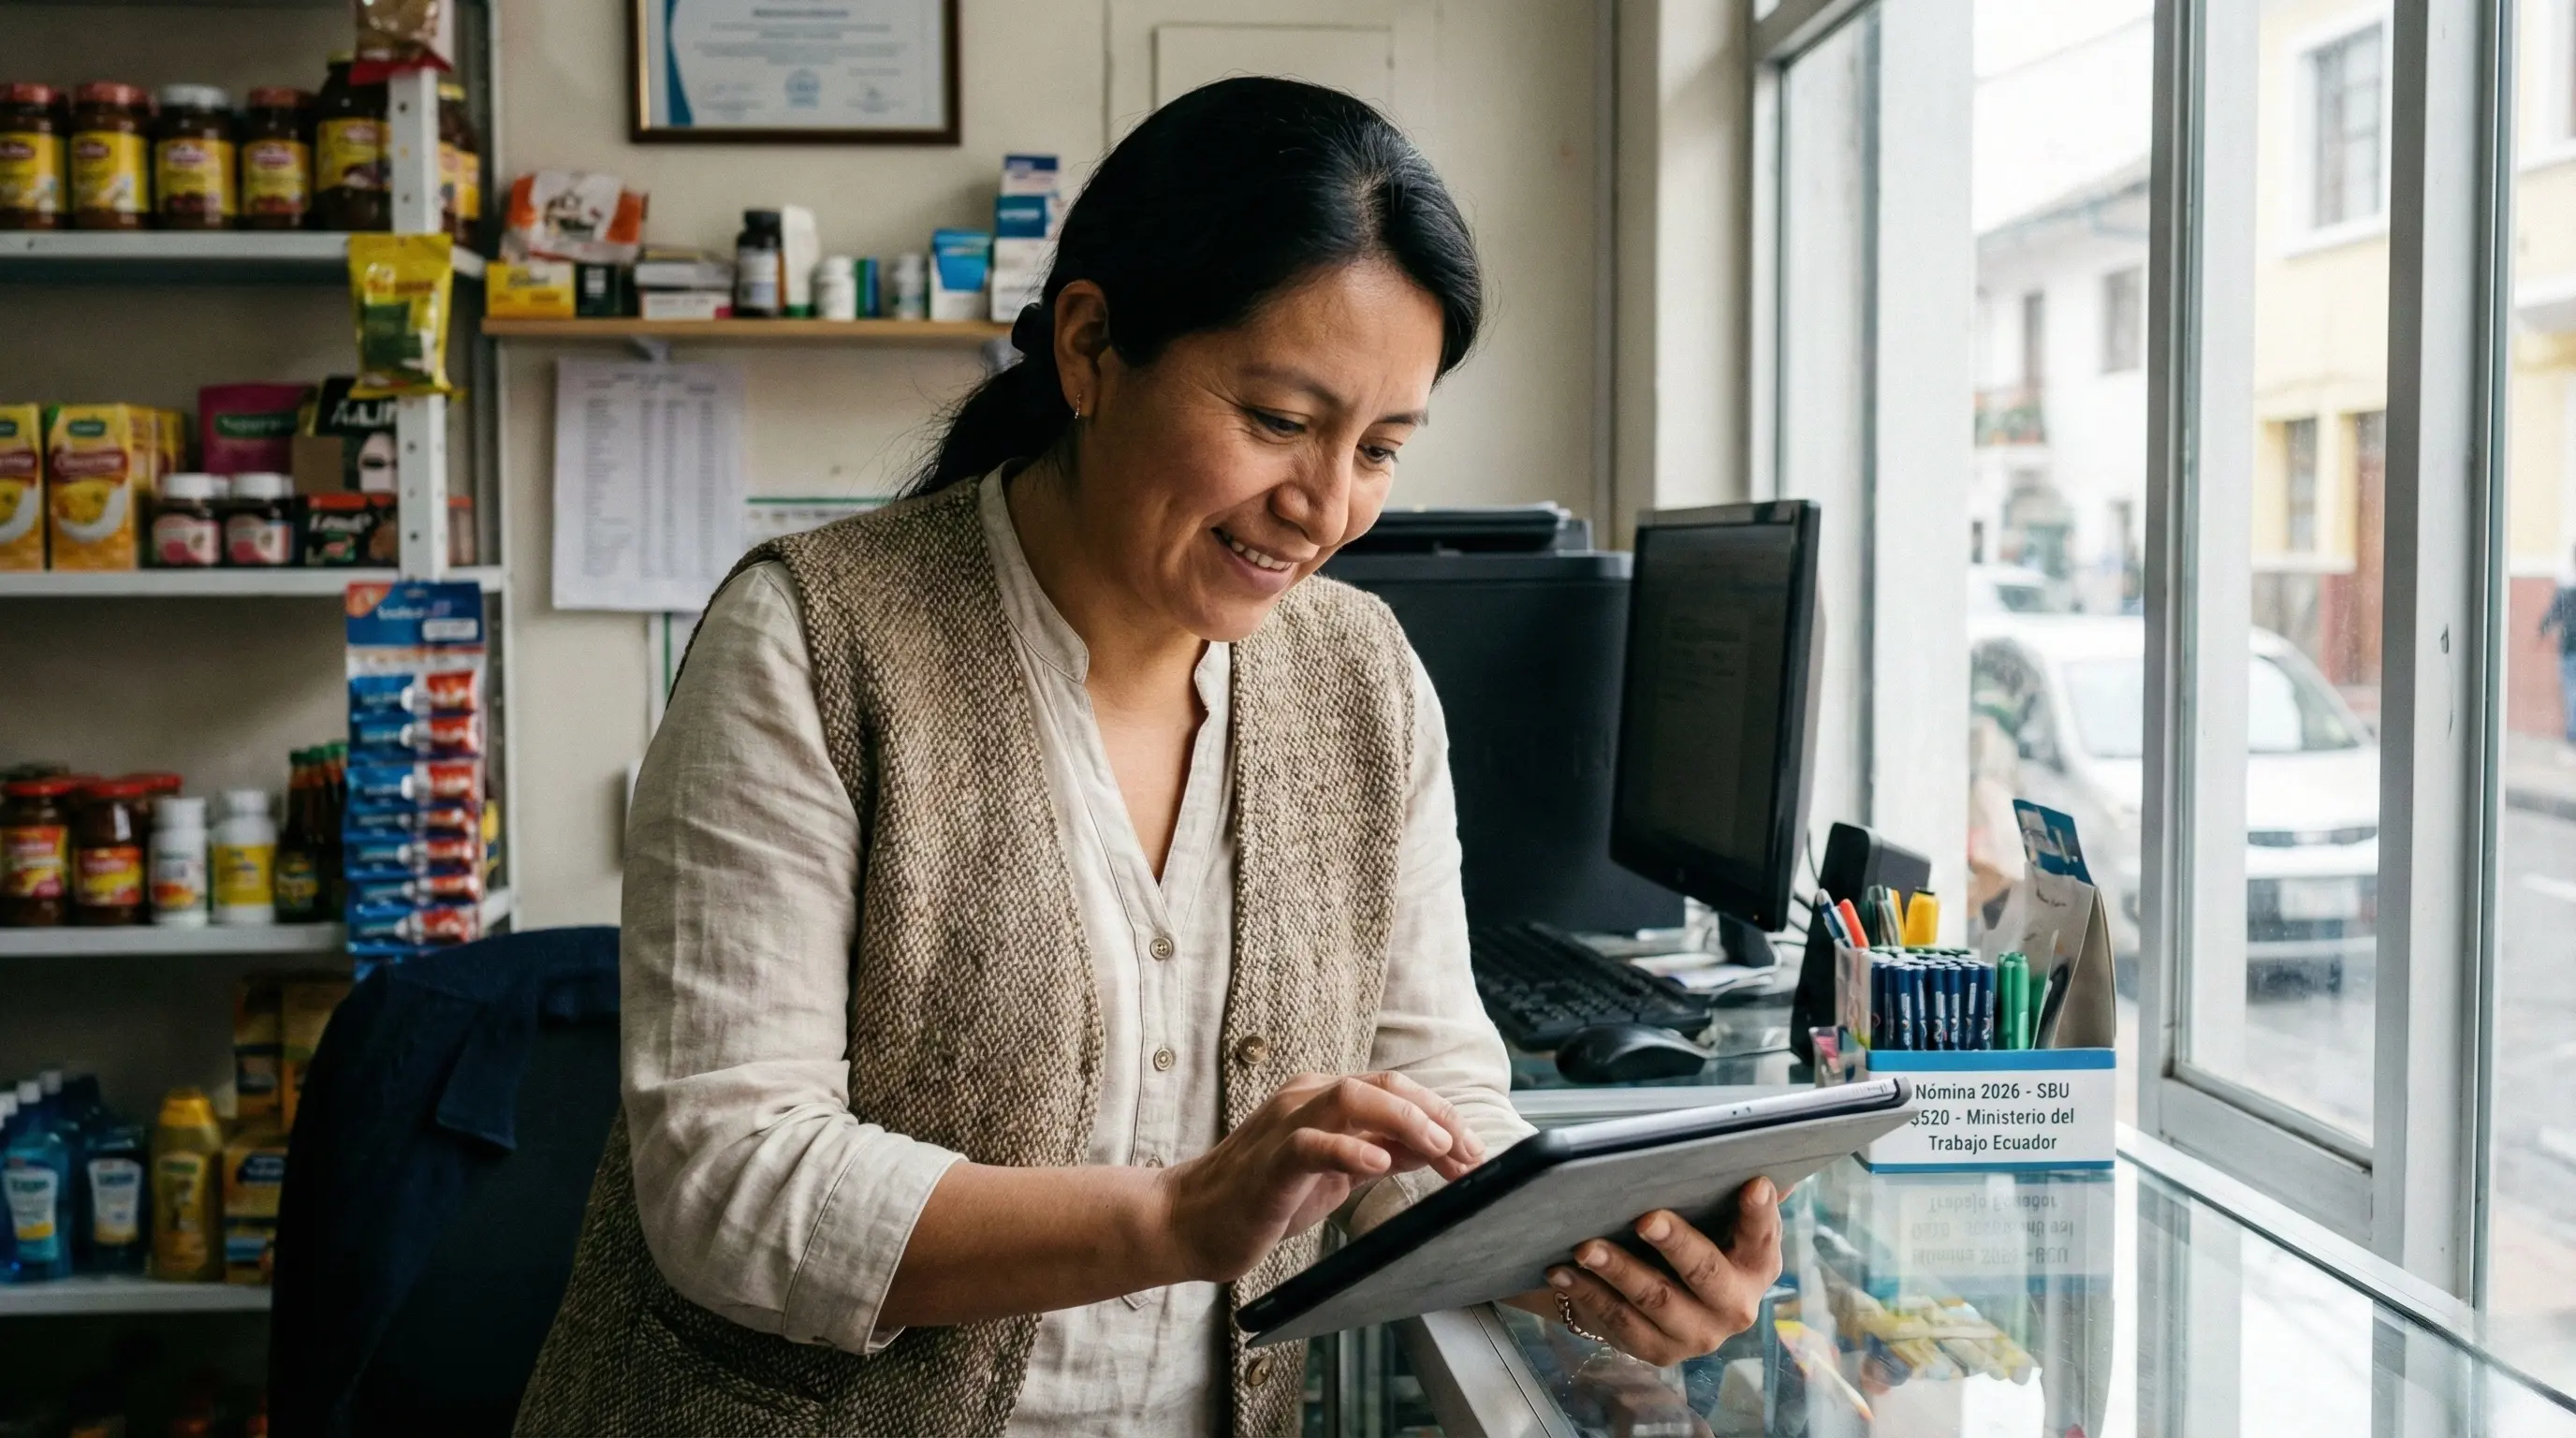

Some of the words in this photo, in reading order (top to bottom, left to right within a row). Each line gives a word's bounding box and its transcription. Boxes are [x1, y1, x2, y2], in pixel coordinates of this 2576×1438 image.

[1915, 1082, 1976, 1100] Nómina
[1981, 1082, 2021, 1100] 2026
[2037, 1082, 2070, 1099] SBU
[1967, 1108, 2046, 1125] Ministerio
[2051, 1108, 2074, 1124] del
[1928, 1134, 1988, 1155] Trabajo
[1993, 1133, 2057, 1151] Ecuador
